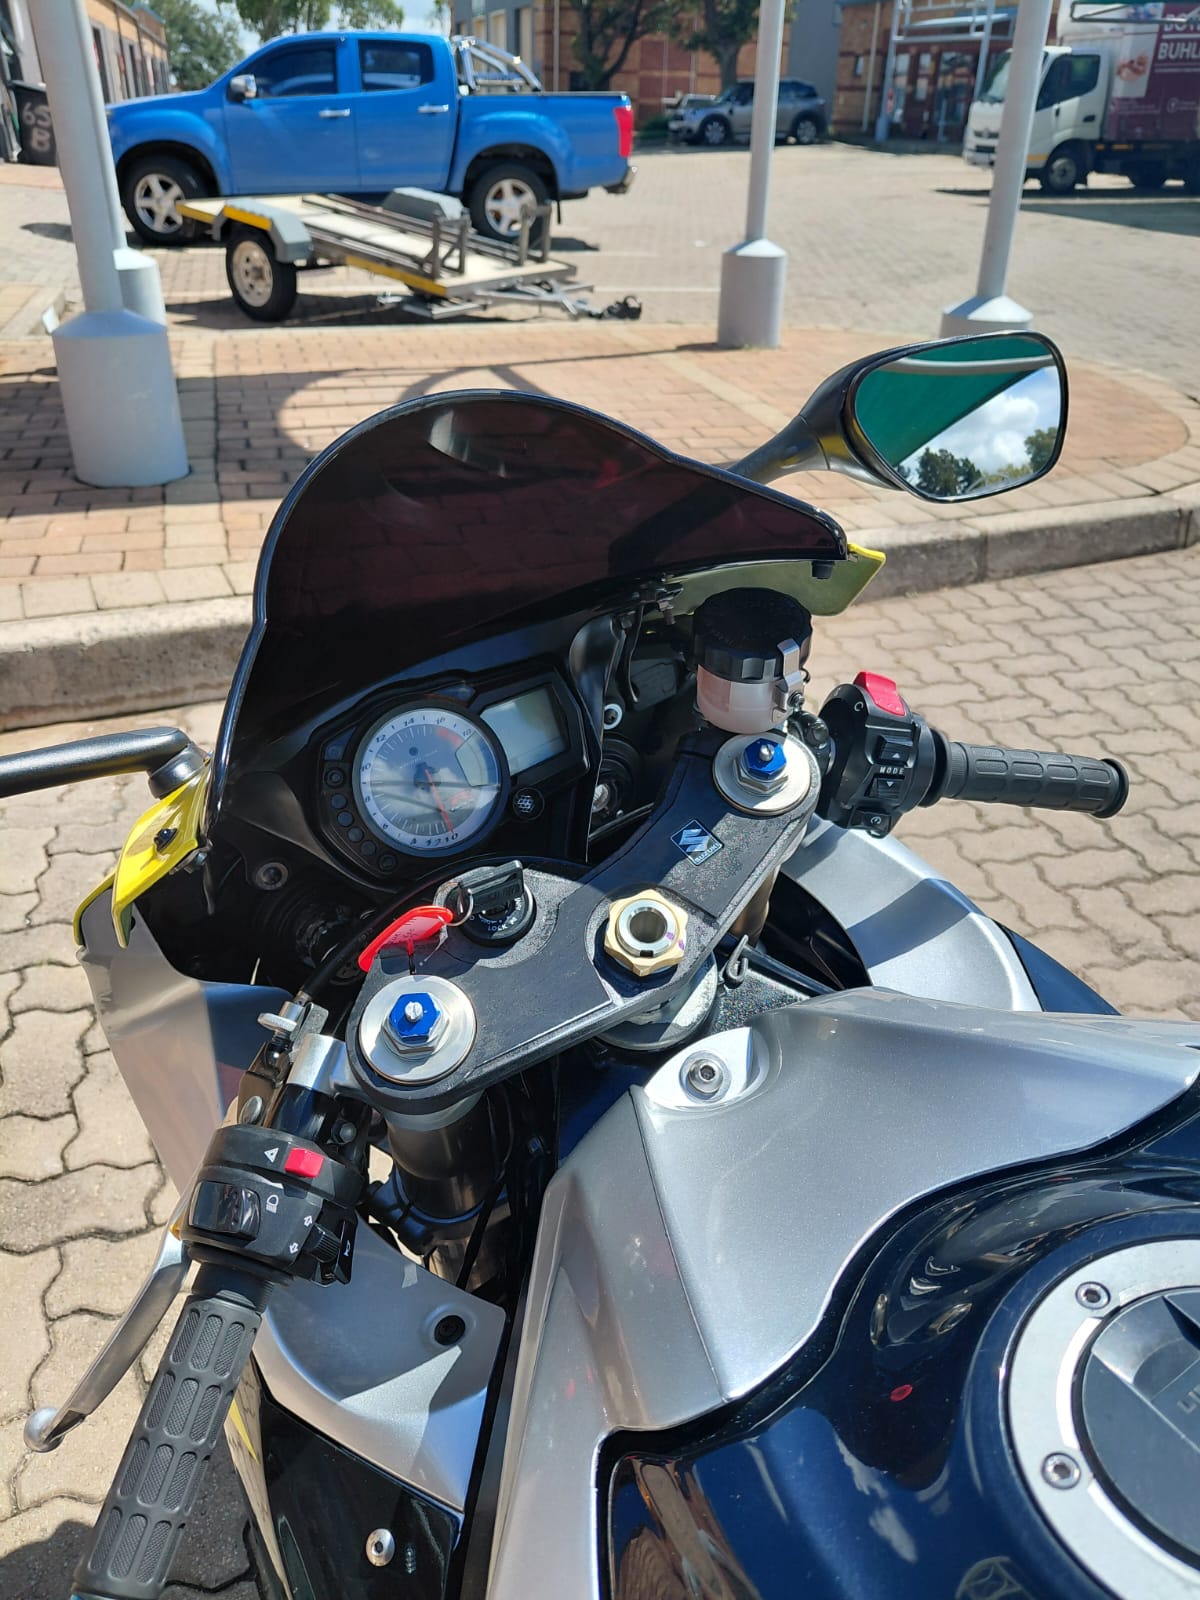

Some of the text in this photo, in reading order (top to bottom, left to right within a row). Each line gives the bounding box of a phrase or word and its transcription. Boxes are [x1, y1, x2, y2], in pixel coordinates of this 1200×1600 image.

[1158, 41, 1200, 60] BUHL
[879, 766, 905, 775] MODE
[694, 843, 719, 862] SUZUKI
[487, 923, 508, 932] LOCK
